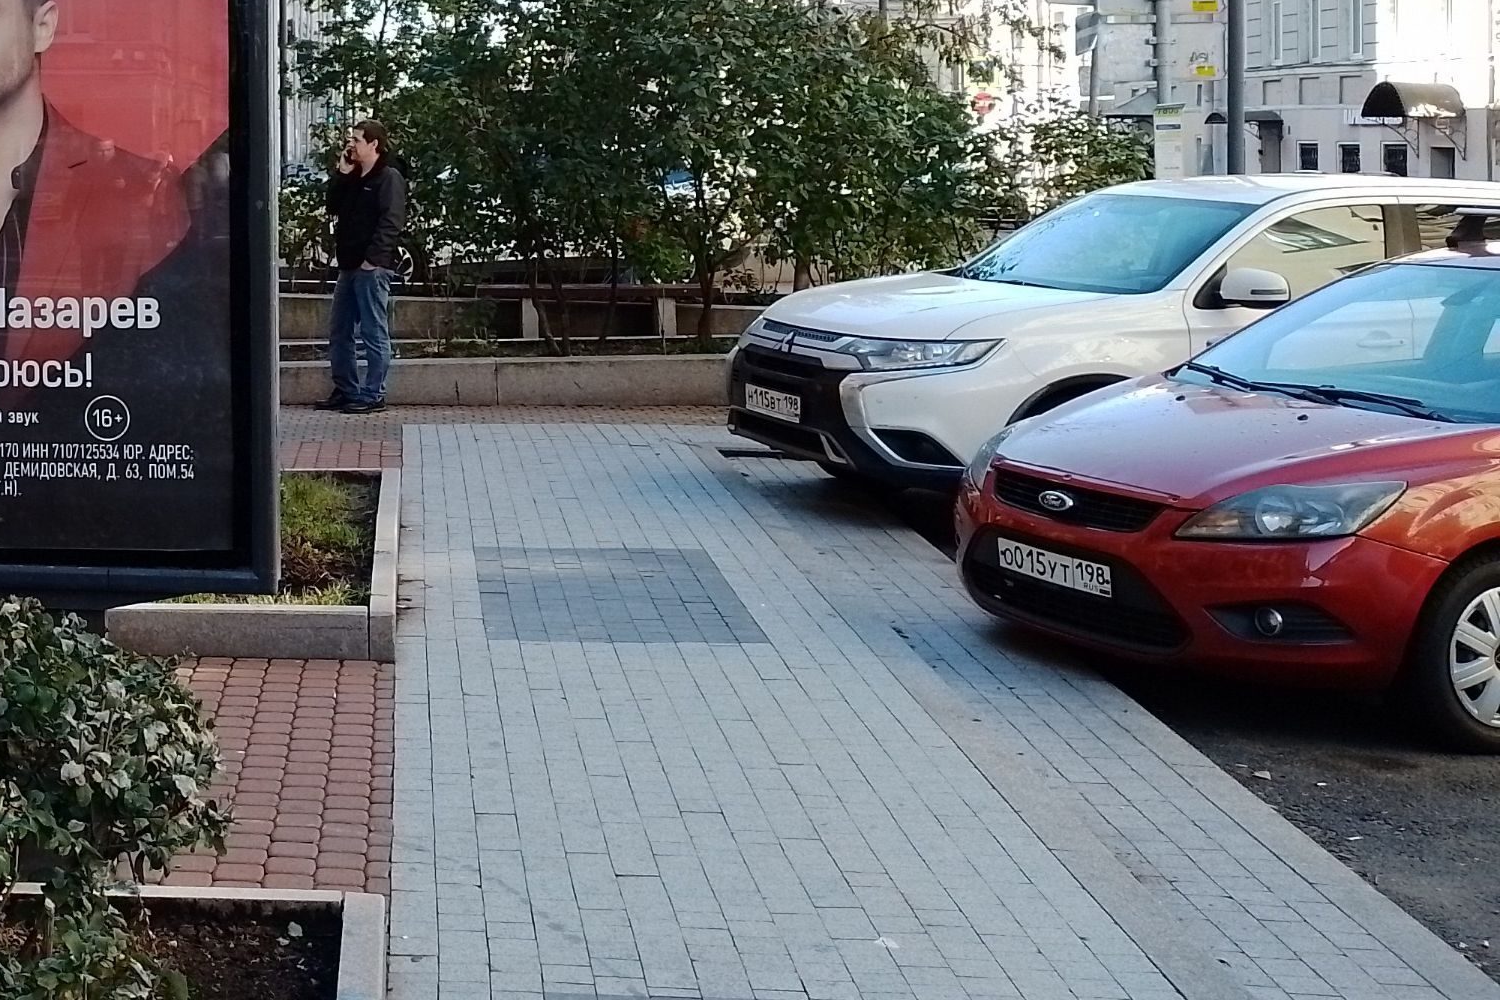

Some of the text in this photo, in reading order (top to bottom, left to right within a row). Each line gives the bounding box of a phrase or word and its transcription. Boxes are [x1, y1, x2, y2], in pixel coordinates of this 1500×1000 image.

[784, 396, 799, 411] 198
[7, 411, 40, 425] звук
[92, 409, 124, 428] 16+
[22, 444, 49, 458] ИНН
[51, 444, 120, 459] 7107125534
[123, 445, 146, 460] ЮР.
[149, 445, 195, 462] АДРЕС:
[3, 462, 102, 480] ДЕМИДОВСКАЯ,
[106, 463, 121, 481] Д.
[125, 464, 143, 480] 63,
[148, 464, 195, 479] ПОМ.54
[1075, 562, 1106, 585] 198
[1083, 582, 1099, 592] RUS
